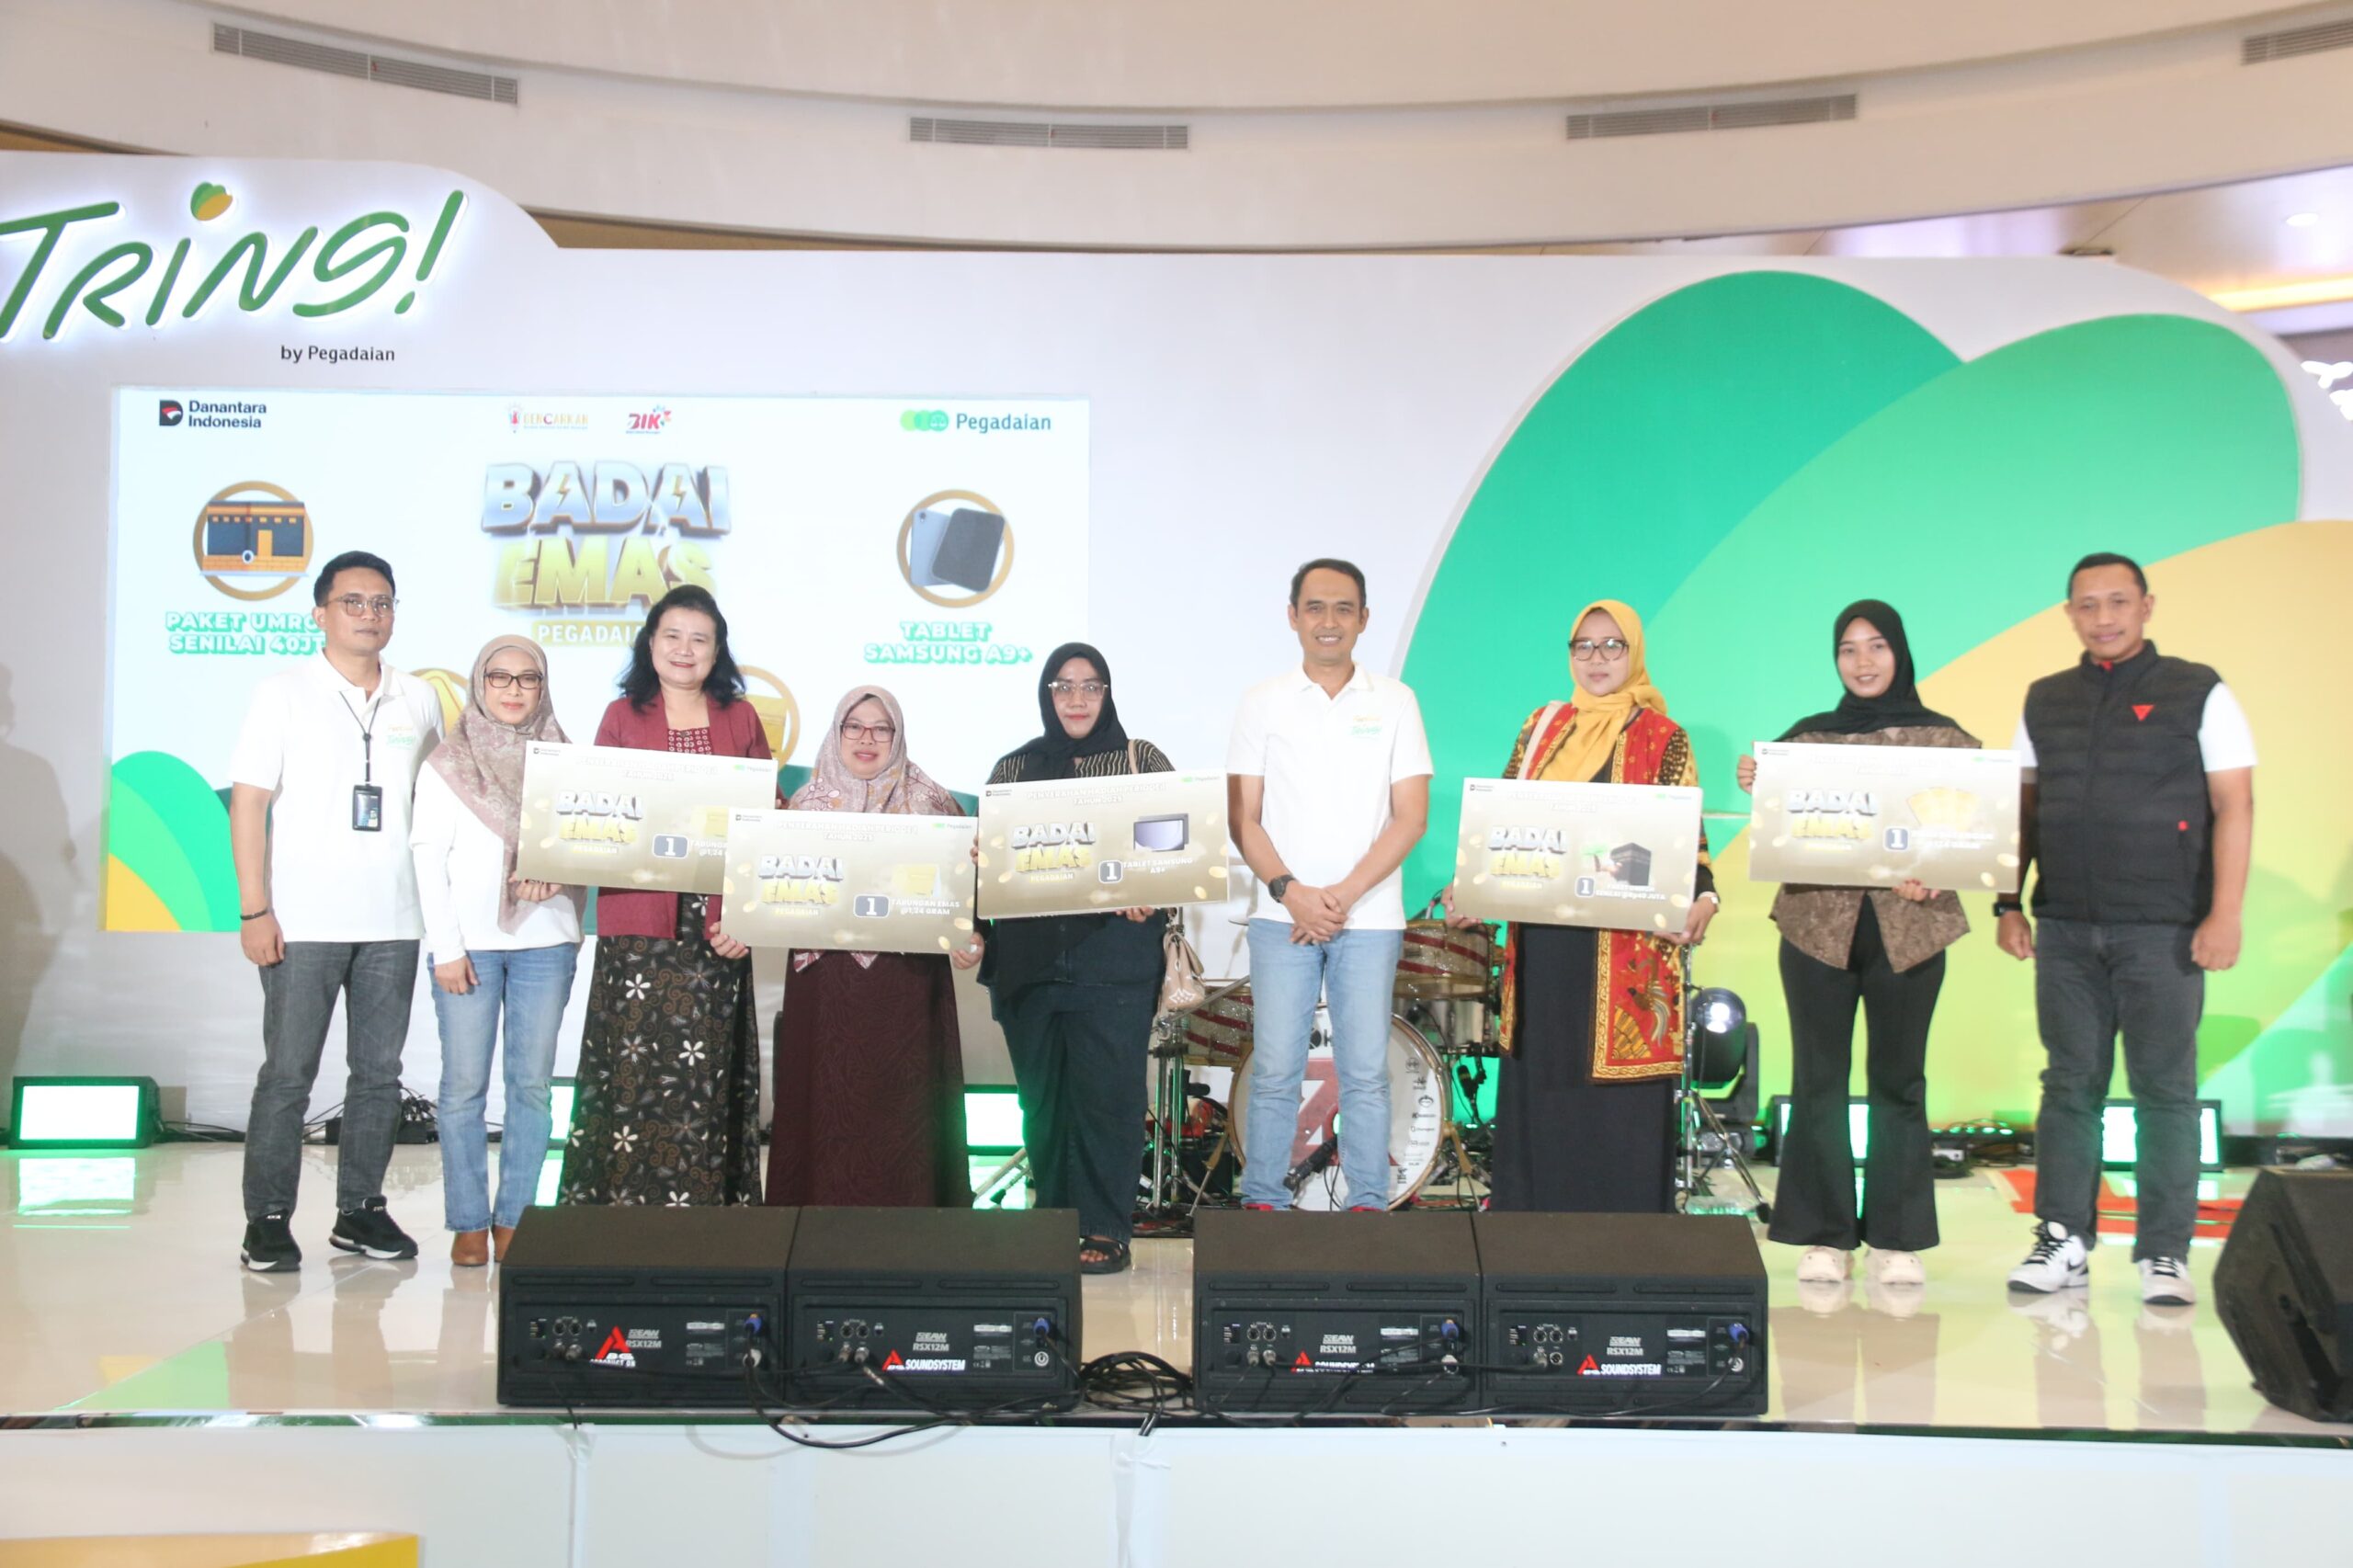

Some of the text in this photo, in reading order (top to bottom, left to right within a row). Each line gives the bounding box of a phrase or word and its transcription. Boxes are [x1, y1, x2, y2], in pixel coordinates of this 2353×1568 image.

[280, 346, 396, 363] by Pegadaian
[188, 400, 267, 414] Danantara
[188, 415, 262, 428] Indonesia
[956, 413, 1051, 434] Pegadaian
[481, 460, 732, 539] BADAI
[492, 536, 718, 612] EMAS
[165, 612, 320, 633] PAKET UMRO
[900, 621, 993, 642] TABLET
[538, 624, 643, 643] PEGADAI
[168, 634, 266, 654] SENILAI
[864, 643, 1033, 665] SAMSUNG A9+
[556, 790, 643, 820] BADAI
[1012, 822, 1096, 847] BADAI
[1489, 827, 1567, 853] BADAI
[1891, 829, 1905, 848] 1
[665, 837, 676, 856] 1
[758, 855, 844, 881] BADAI
[1016, 846, 1094, 872] EMAS
[1106, 863, 1118, 881] 1
[1580, 879, 1591, 894] 1
[867, 897, 878, 916] 1
[913, 1343, 949, 1351] RSX12M
[1320, 1345, 1357, 1353] RSX12M
[1607, 1346, 1643, 1356] RSX12M
[905, 1358, 966, 1370] SOUNDSYSTEM
[1600, 1363, 1662, 1375] SOUNDSYSTEM
